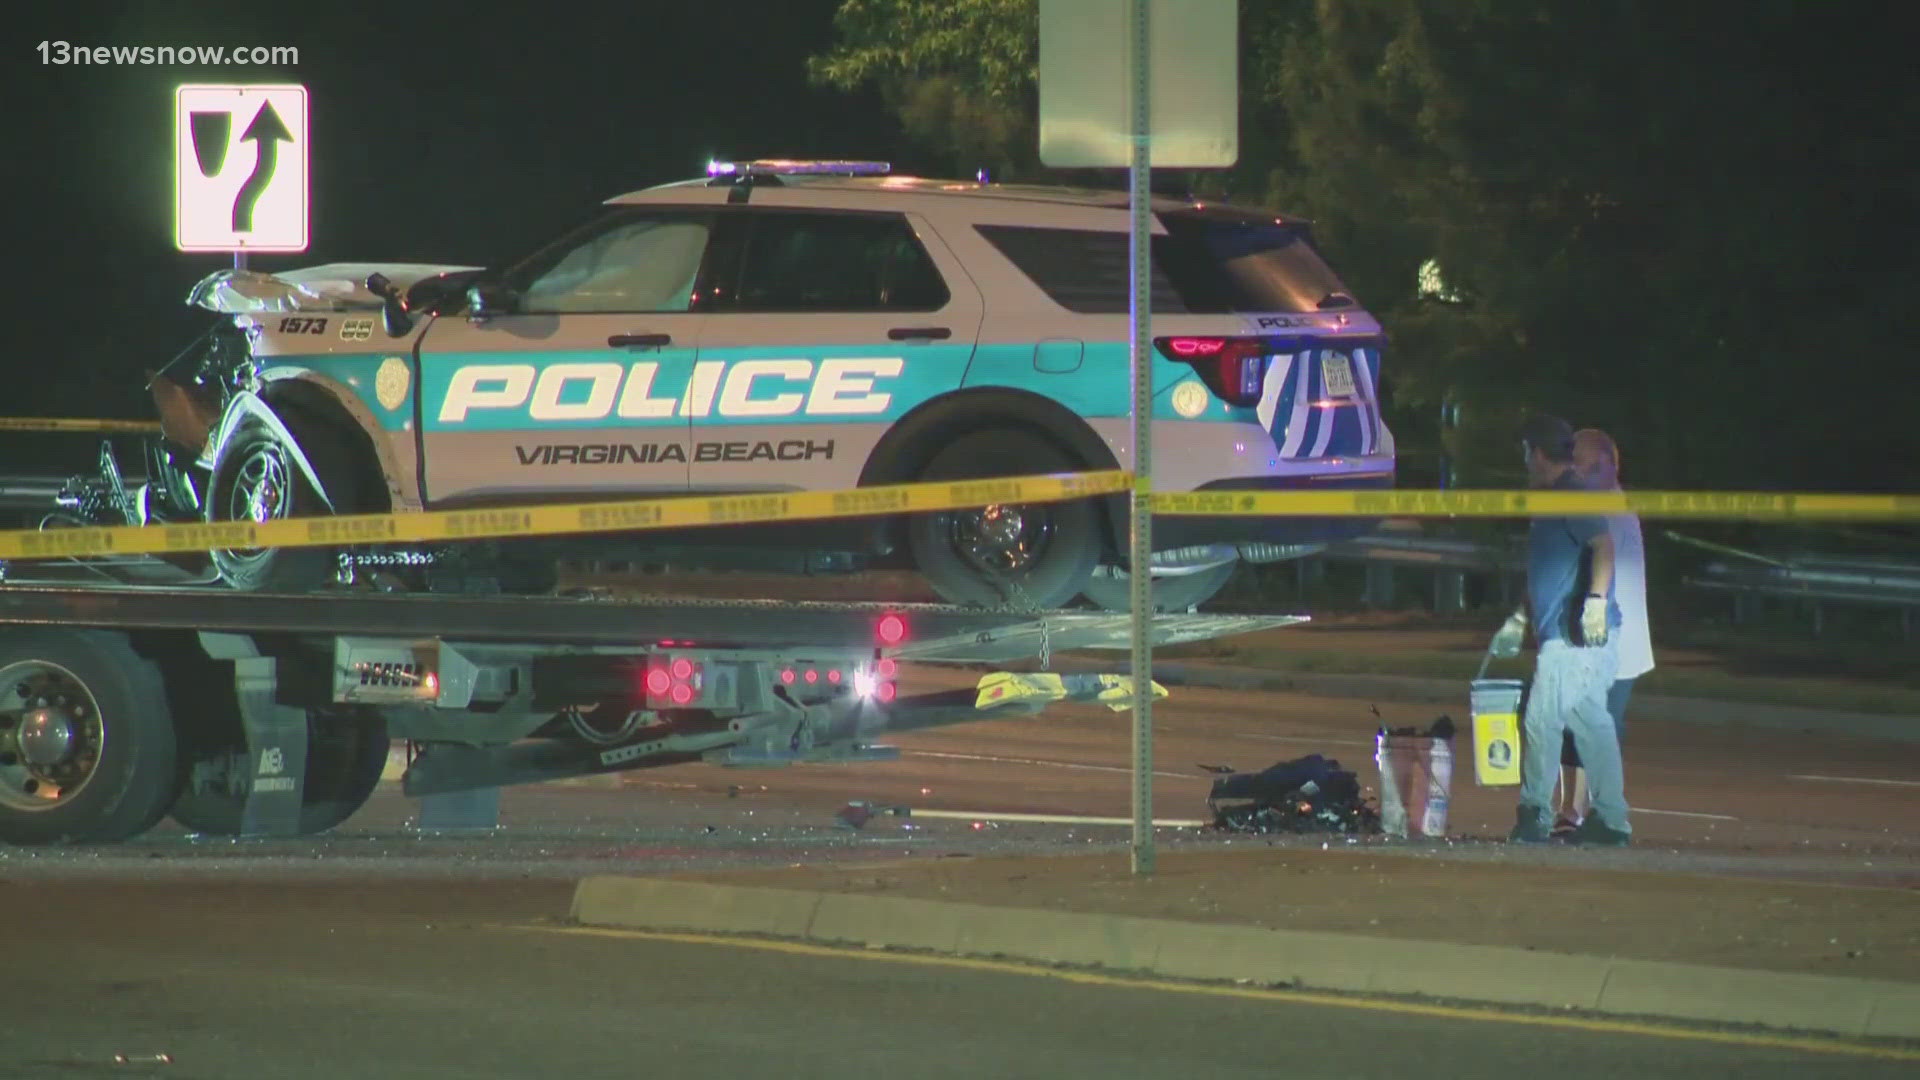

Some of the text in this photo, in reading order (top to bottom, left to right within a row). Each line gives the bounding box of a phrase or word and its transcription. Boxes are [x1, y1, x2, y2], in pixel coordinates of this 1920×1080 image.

[279, 318, 328, 334] 1573
[1258, 317, 1321, 329] POLIC
[438, 358, 904, 422] POLICE
[516, 439, 834, 465] VIRGINIA BEACH
